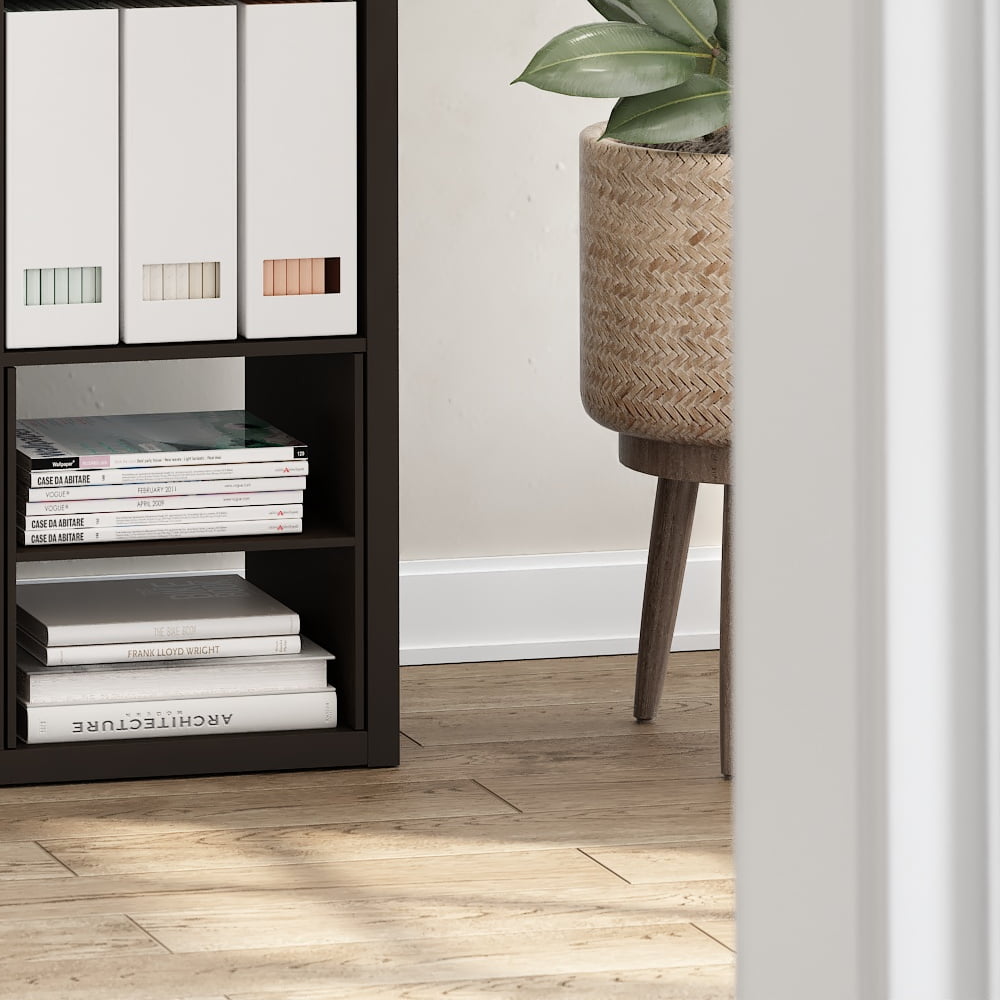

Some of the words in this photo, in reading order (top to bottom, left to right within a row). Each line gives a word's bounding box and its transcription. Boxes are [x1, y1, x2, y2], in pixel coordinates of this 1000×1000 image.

[38, 476, 53, 484] CASE
[55, 476, 63, 484] DA
[64, 475, 90, 484] ABITARE
[31, 520, 47, 528] CASE
[49, 519, 57, 528] DA
[58, 518, 84, 528] ABITARE
[31, 534, 47, 543] CASE
[49, 534, 57, 542] DA
[58, 533, 84, 542] ABITARE
[128, 649, 155, 659] FRANK
[156, 648, 184, 657] LLOYD
[186, 646, 220, 656] WRIGHT
[72, 713, 233, 733] ARCHITECTURE
